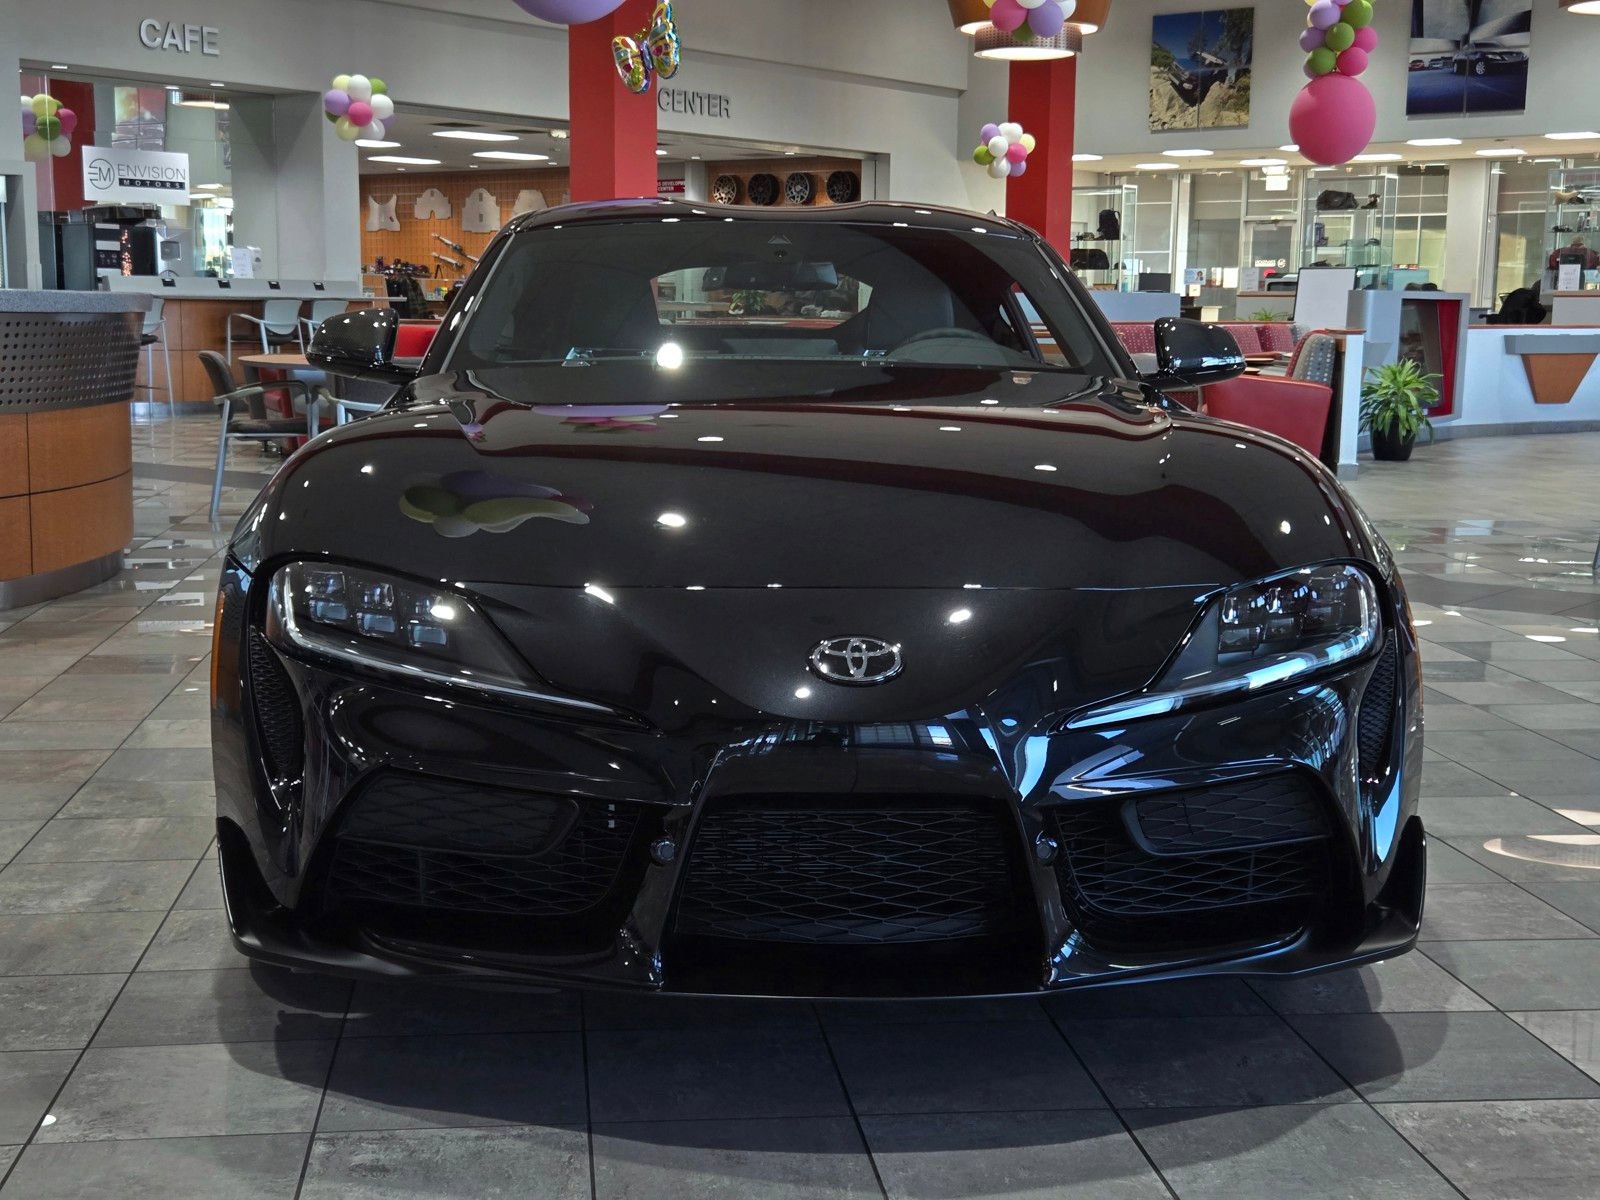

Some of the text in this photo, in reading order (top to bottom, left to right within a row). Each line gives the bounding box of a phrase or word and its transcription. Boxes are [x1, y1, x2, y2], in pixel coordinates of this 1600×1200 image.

[139, 18, 220, 56] CAFE
[658, 87, 731, 118] CENTER
[117, 163, 186, 180] ENVISION
[123, 180, 181, 189] MOTORS
